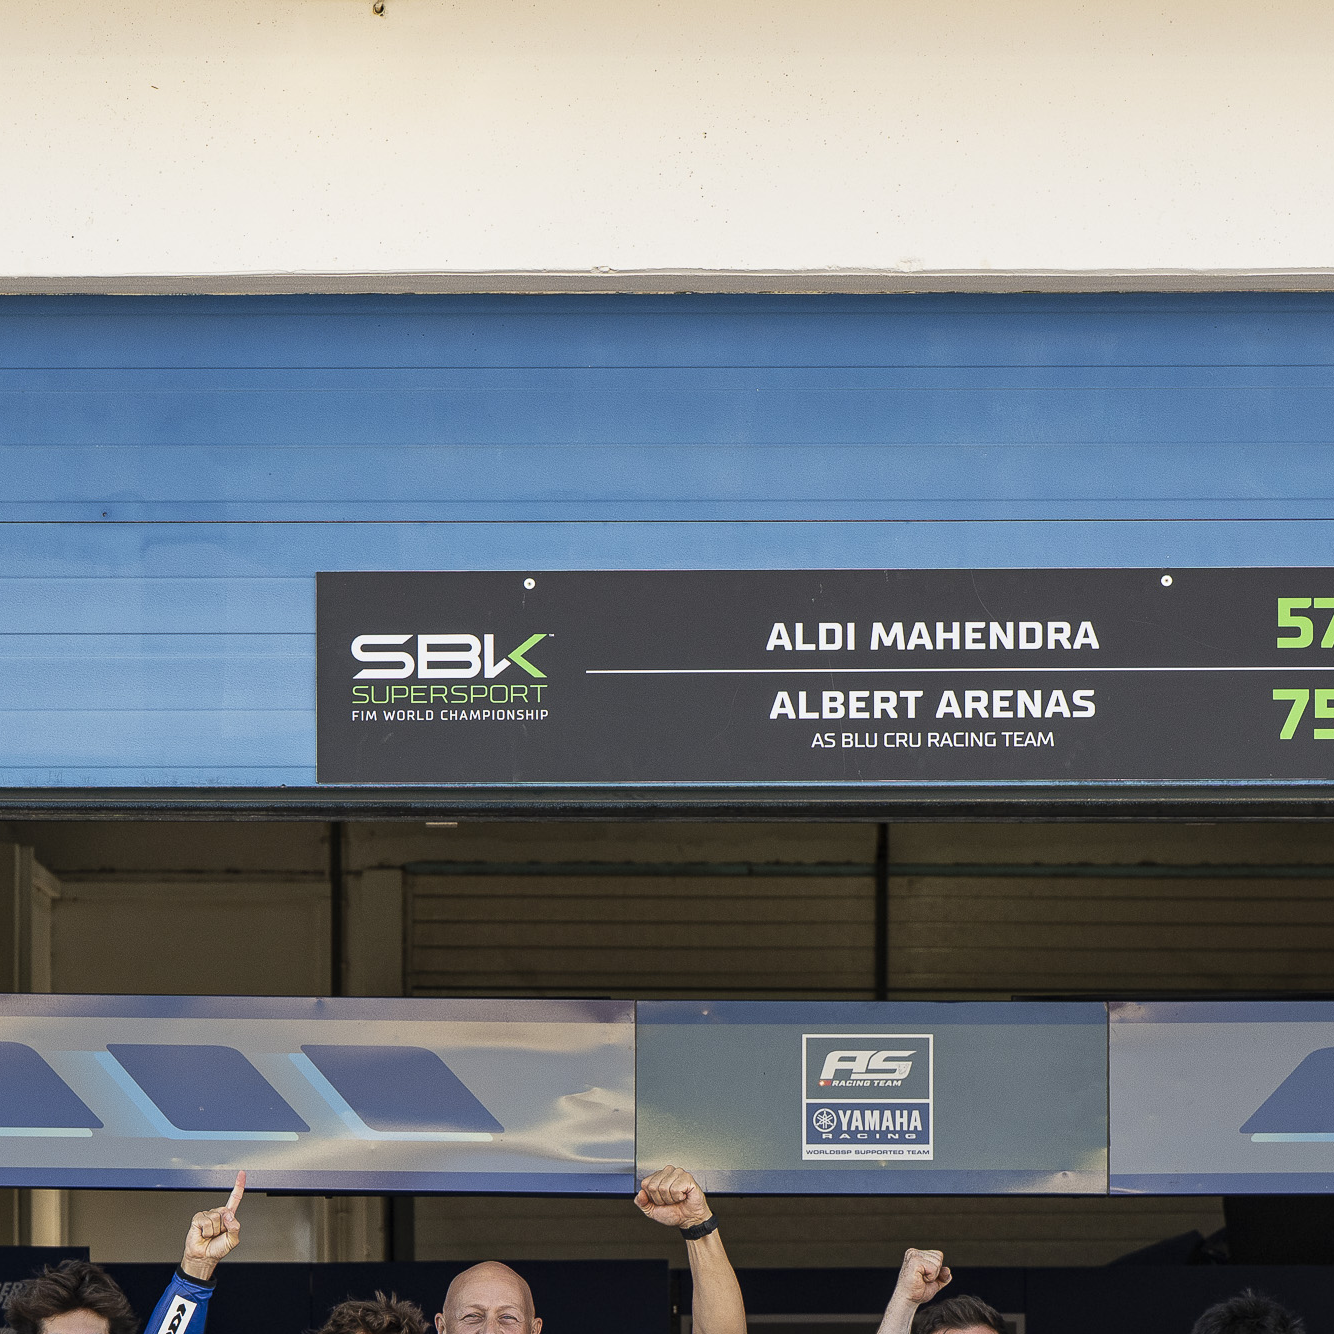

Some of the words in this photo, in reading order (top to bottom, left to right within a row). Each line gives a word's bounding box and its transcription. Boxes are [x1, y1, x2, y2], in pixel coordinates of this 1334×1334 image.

[766, 622, 855, 650] ALDI
[870, 621, 1100, 650] MAHENDRA
[351, 633, 548, 679] SBK
[351, 684, 549, 704] SUPERSPORT
[769, 690, 924, 720] ALBERT
[935, 689, 1096, 719] ARENAS
[351, 709, 378, 721] FIM
[383, 709, 434, 721] WORLD
[440, 709, 549, 721] CHAMPIONSHIP
[811, 732, 836, 748] AS
[841, 732, 877, 748] BLU
[883, 732, 922, 748] CRU
[927, 731, 997, 748] RACING
[1001, 731, 1055, 747] TEAM
[820, 1050, 917, 1080] AS
[838, 1110, 922, 1131] YAMAHA
